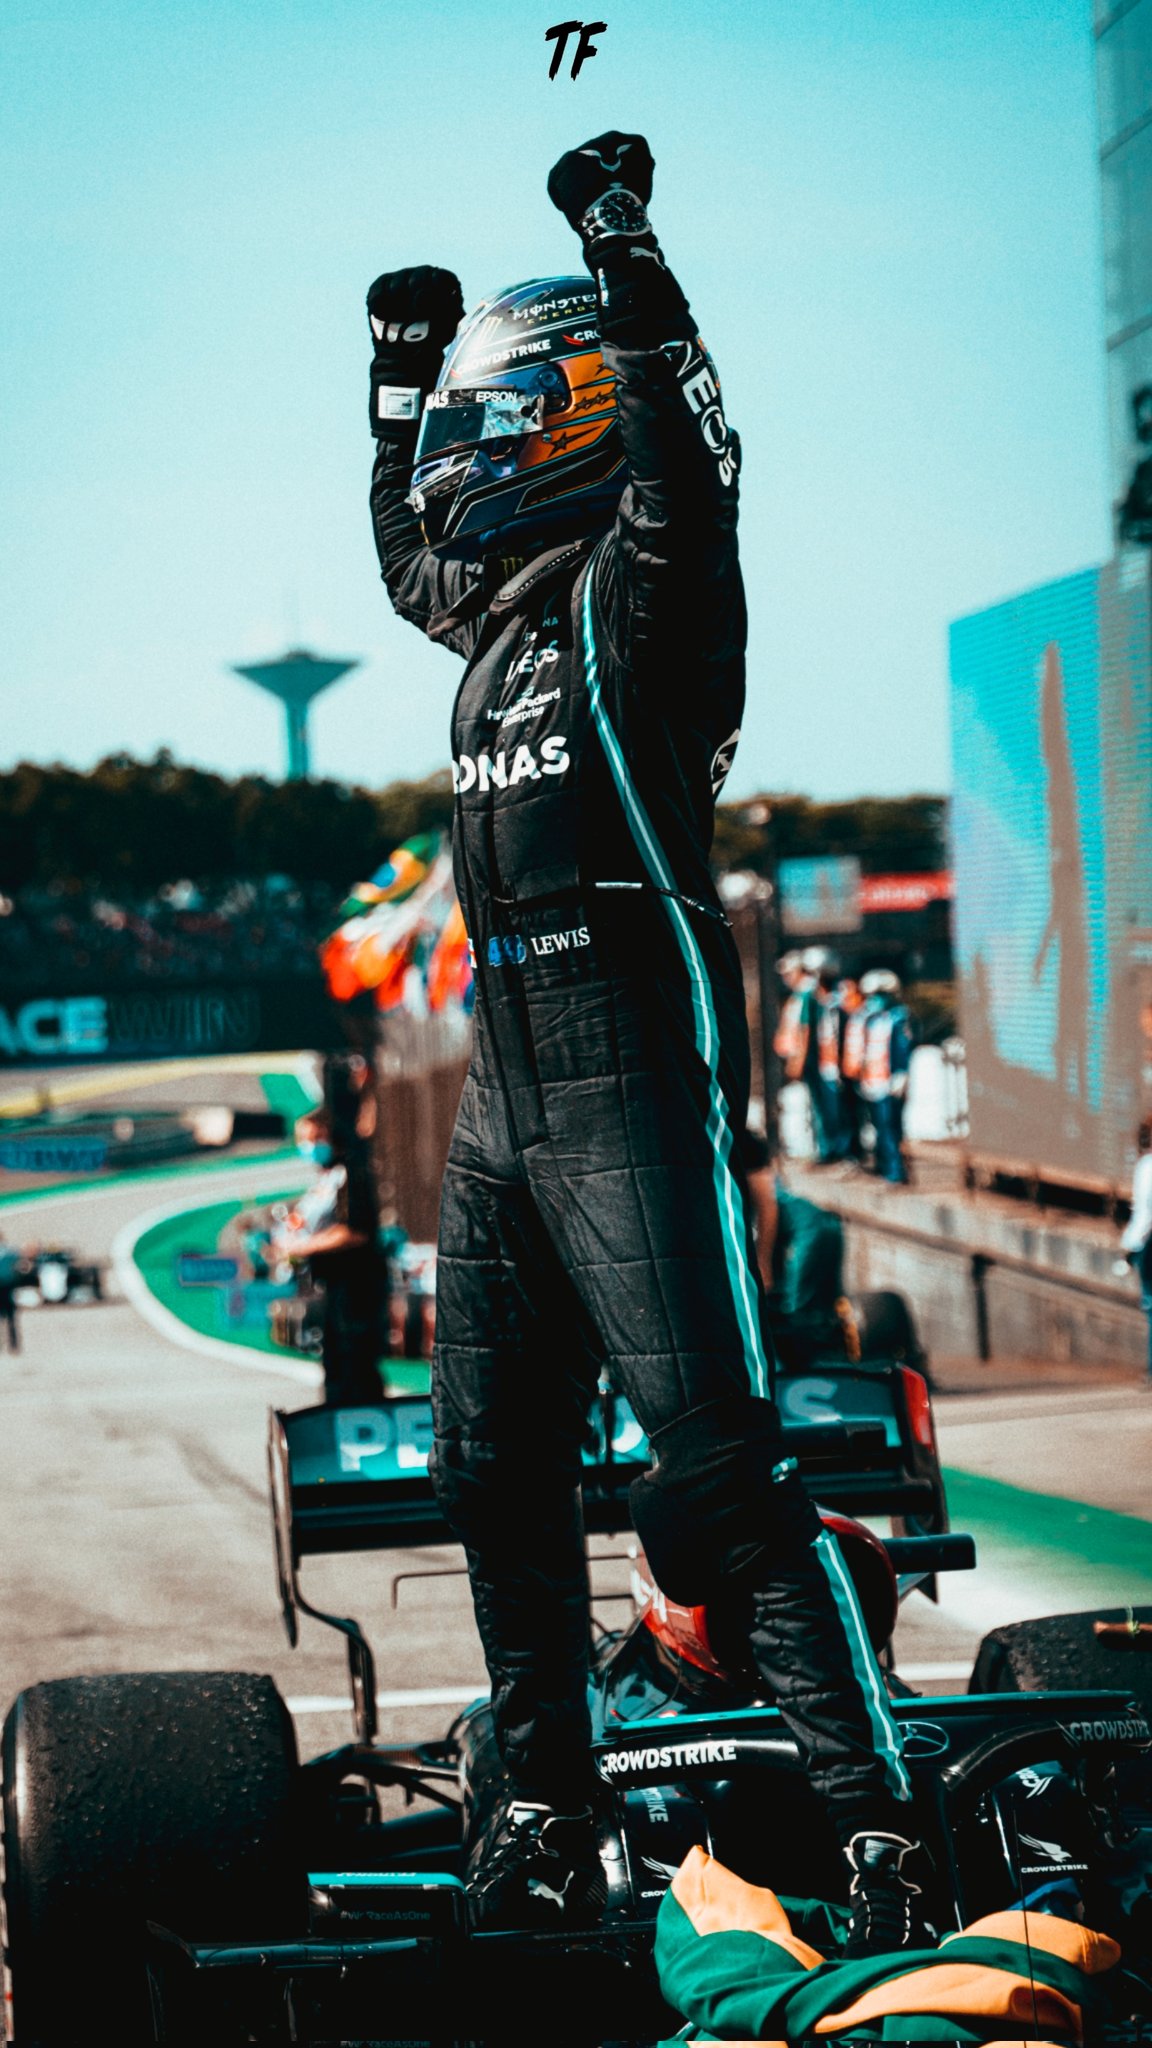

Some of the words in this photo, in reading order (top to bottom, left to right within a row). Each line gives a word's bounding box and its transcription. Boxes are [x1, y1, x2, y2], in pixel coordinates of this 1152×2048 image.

[457, 338, 552, 374] CROWDSTRIKE
[475, 391, 517, 403] EPSON
[521, 687, 561, 709] Packard
[531, 926, 591, 956] LEWIS
[600, 1740, 737, 1774] CROWDSTRIKE
[1021, 1864, 1089, 1874] CROWDSTRIKE
